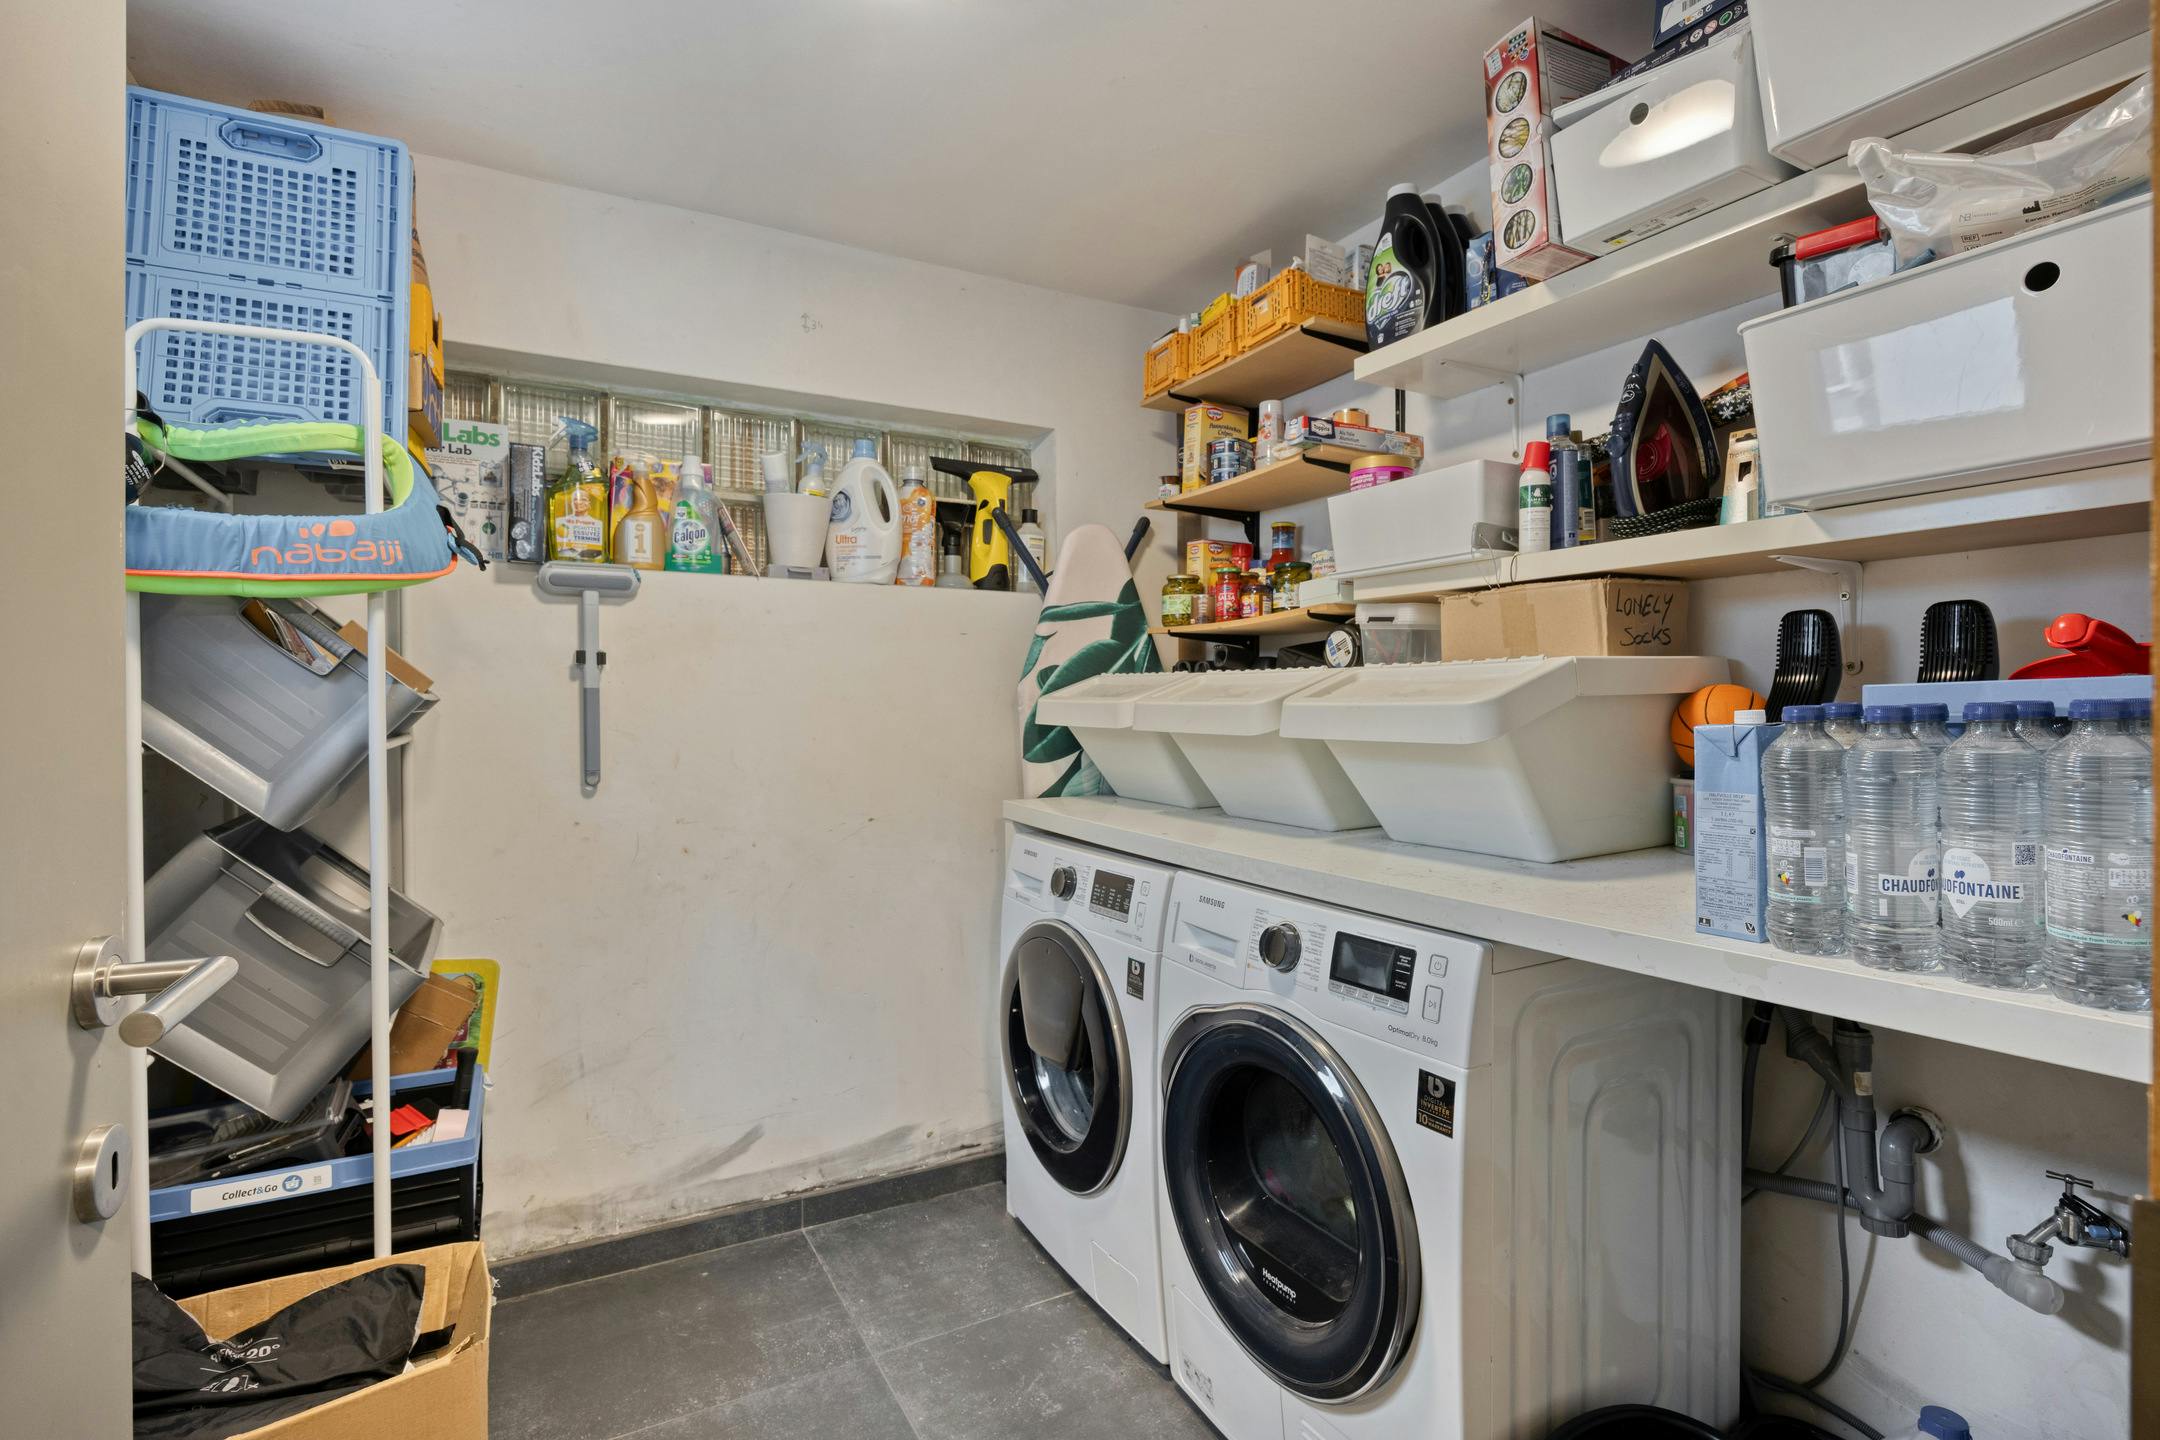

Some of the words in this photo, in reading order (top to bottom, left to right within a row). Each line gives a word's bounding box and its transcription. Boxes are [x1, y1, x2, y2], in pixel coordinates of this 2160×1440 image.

[442, 422, 500, 447] Labs
[448, 444, 472, 455] Lab
[674, 527, 706, 544] Calgon
[835, 535, 858, 545] Ultra
[251, 540, 404, 566] nabaiji
[1616, 588, 1675, 625] LONELY
[1199, 895, 1226, 909] SAMSUNG
[1420, 1099, 1450, 1116] INVERTER
[1418, 1113, 1428, 1125] 10
[222, 1184, 278, 1201] Collect&Go
[1262, 1267, 1297, 1299] Heatpump
